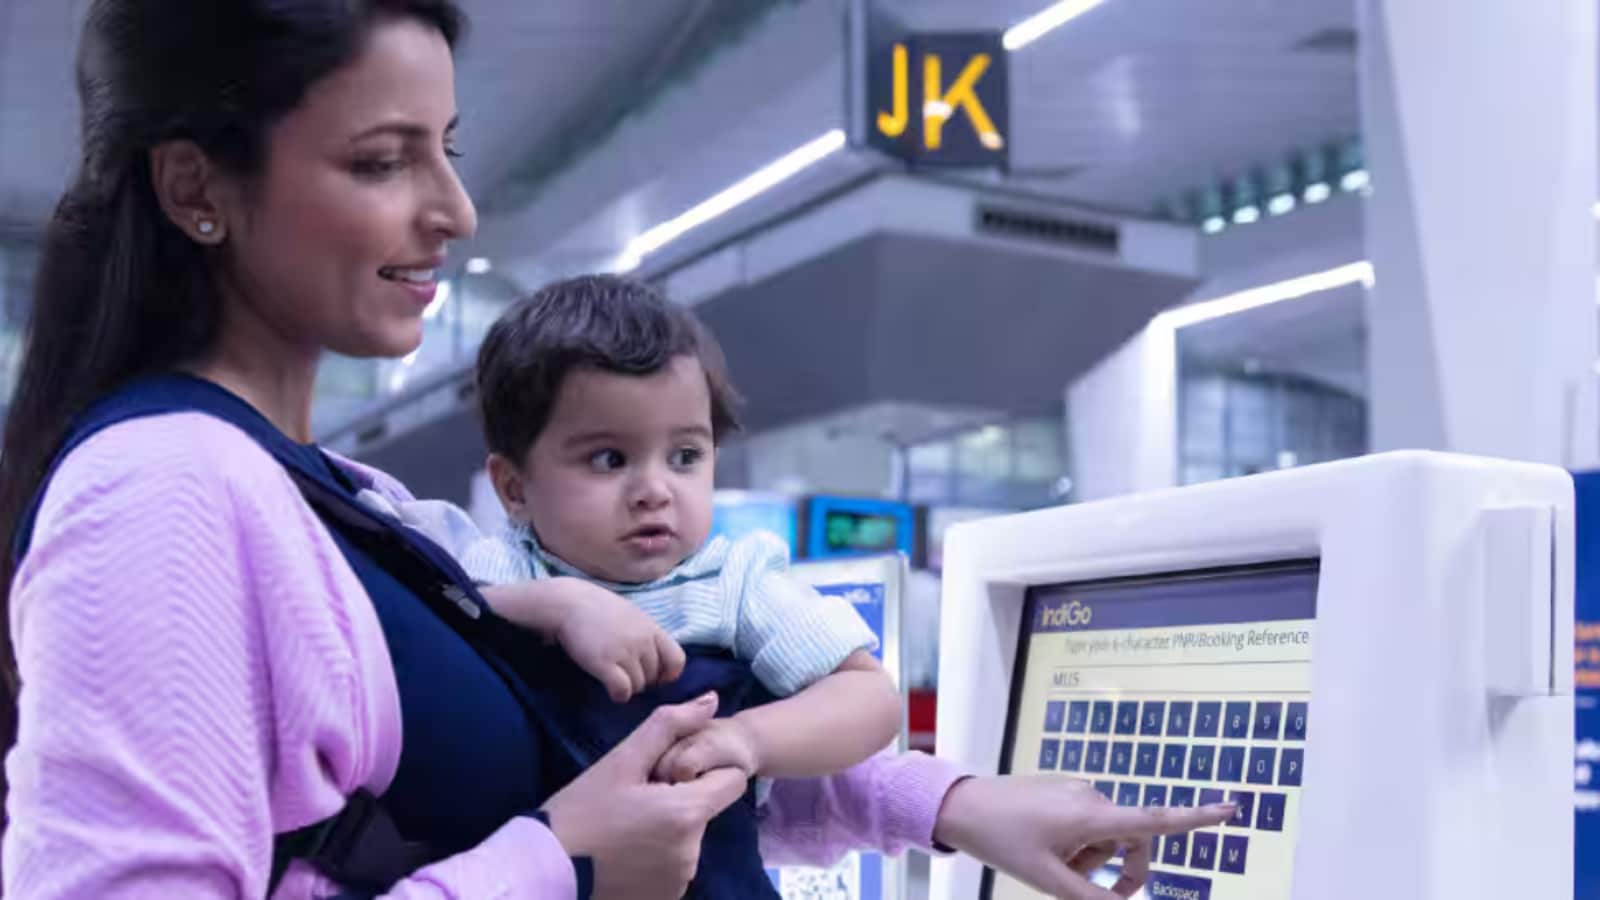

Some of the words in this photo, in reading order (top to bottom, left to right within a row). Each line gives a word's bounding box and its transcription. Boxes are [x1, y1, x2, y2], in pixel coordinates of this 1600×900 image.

[877, 43, 909, 138] J
[922, 53, 1004, 151] K
[1041, 600, 1092, 627] IndiGo
[1248, 628, 1309, 647] Reference
[1204, 713, 1212, 729] 7
[1232, 714, 1241, 729] 8
[1263, 714, 1272, 730] 9
[1288, 760, 1297, 776] P
[1171, 841, 1180, 856] B
[1200, 846, 1208, 860] N
[1228, 848, 1239, 864] M
[1152, 880, 1200, 900] Backspace
